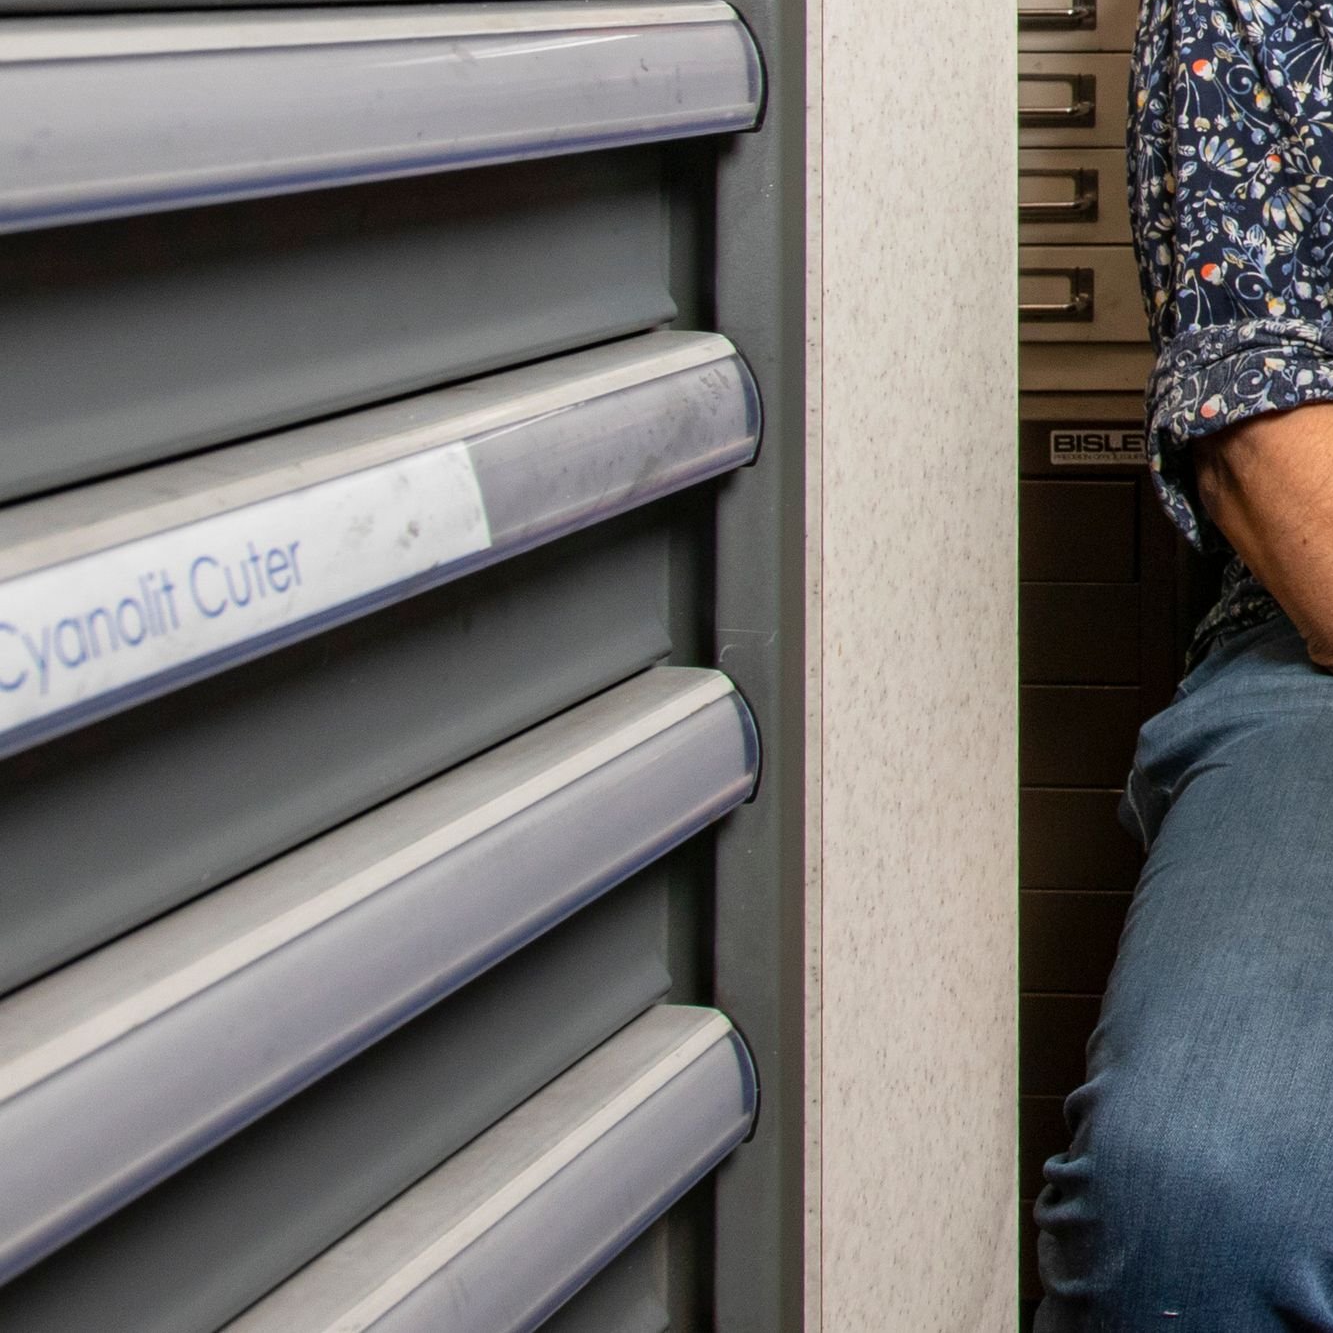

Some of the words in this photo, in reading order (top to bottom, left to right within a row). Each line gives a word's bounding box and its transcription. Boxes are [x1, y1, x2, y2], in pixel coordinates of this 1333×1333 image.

[1054, 434, 1145, 453] BISLE
[0, 568, 180, 696] Cyanolit
[188, 540, 303, 619] Cuter
